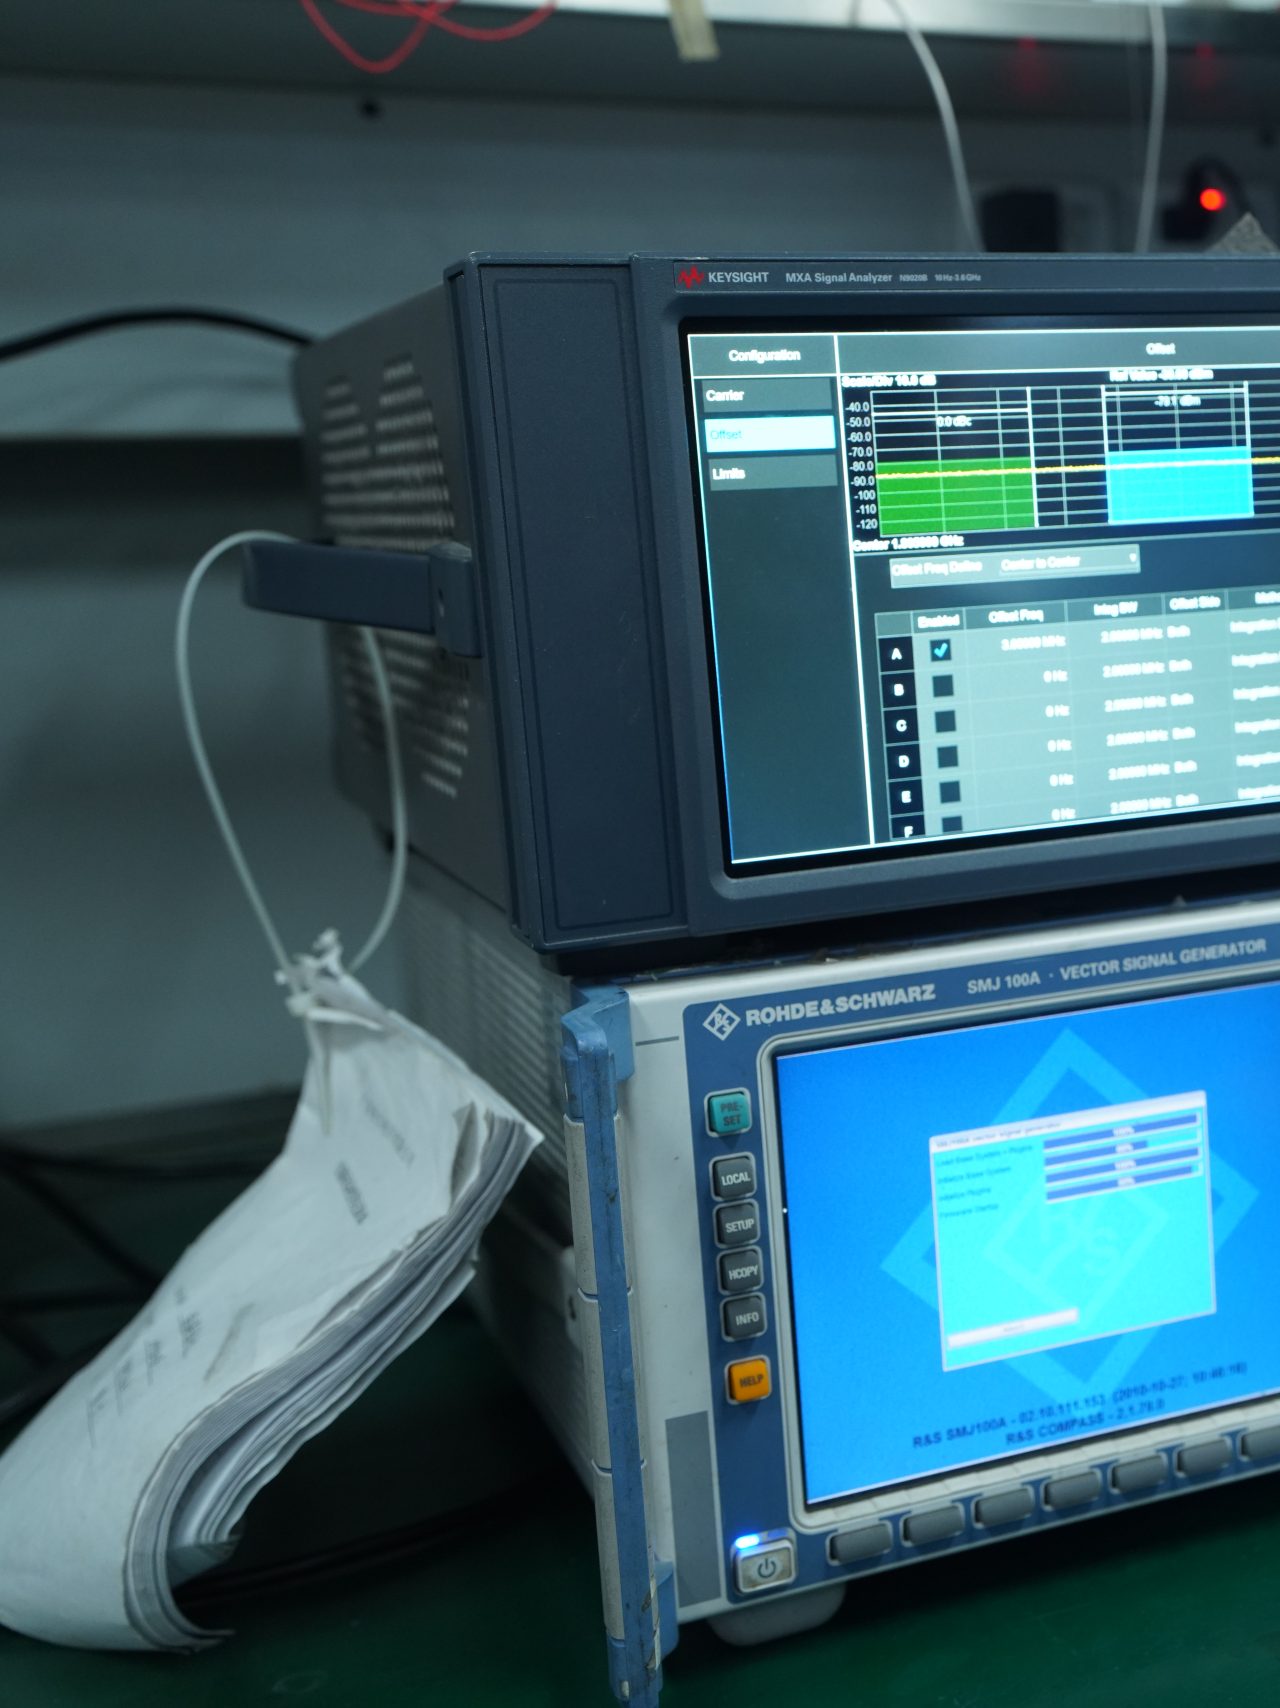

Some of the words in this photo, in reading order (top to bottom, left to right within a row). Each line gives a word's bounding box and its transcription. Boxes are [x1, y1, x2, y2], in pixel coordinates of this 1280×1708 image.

[708, 271, 769, 283] KEYSIGHT
[785, 272, 812, 283] MXA
[814, 272, 848, 285] Signal
[849, 272, 893, 284] Analyzer
[728, 349, 802, 364] Configuration
[705, 390, 745, 402] Carrier
[845, 401, 870, 413] -40.0
[846, 416, 872, 427] -50.0
[710, 429, 743, 440] Offset
[847, 431, 873, 442] -60.0
[848, 446, 874, 458] -70.0
[849, 461, 875, 472] -80.0
[712, 467, 746, 481] Limits
[850, 475, 876, 487] -90.0
[854, 490, 877, 501] -100
[855, 504, 878, 515] -110
[856, 518, 879, 530] -120
[890, 647, 903, 661] A
[893, 683, 905, 697] B
[895, 719, 908, 733] C
[898, 754, 910, 768] D
[901, 790, 912, 804] E
[967, 976, 1001, 995] SMJ
[1004, 970, 1041, 989] 100A
[1060, 959, 1121, 982] VECTOR
[1122, 951, 1178, 973] SIGNAL
[1179, 938, 1267, 964] GENERATOR
[745, 983, 936, 1027] ROHDE&SCHWARZ
[720, 1101, 744, 1114] PRE-
[723, 1113, 742, 1127] SET
[721, 1171, 752, 1186] LOCAL
[725, 1217, 755, 1233] SETUP
[728, 1264, 759, 1281] HCOPY
[735, 1311, 760, 1326] INFO
[739, 1373, 764, 1388] HELP
[912, 1432, 942, 1449] R&S
[946, 1416, 1007, 1441] SMJ100A
[1006, 1425, 1035, 1446] R&S
[1038, 1411, 1105, 1439] COMPASS
